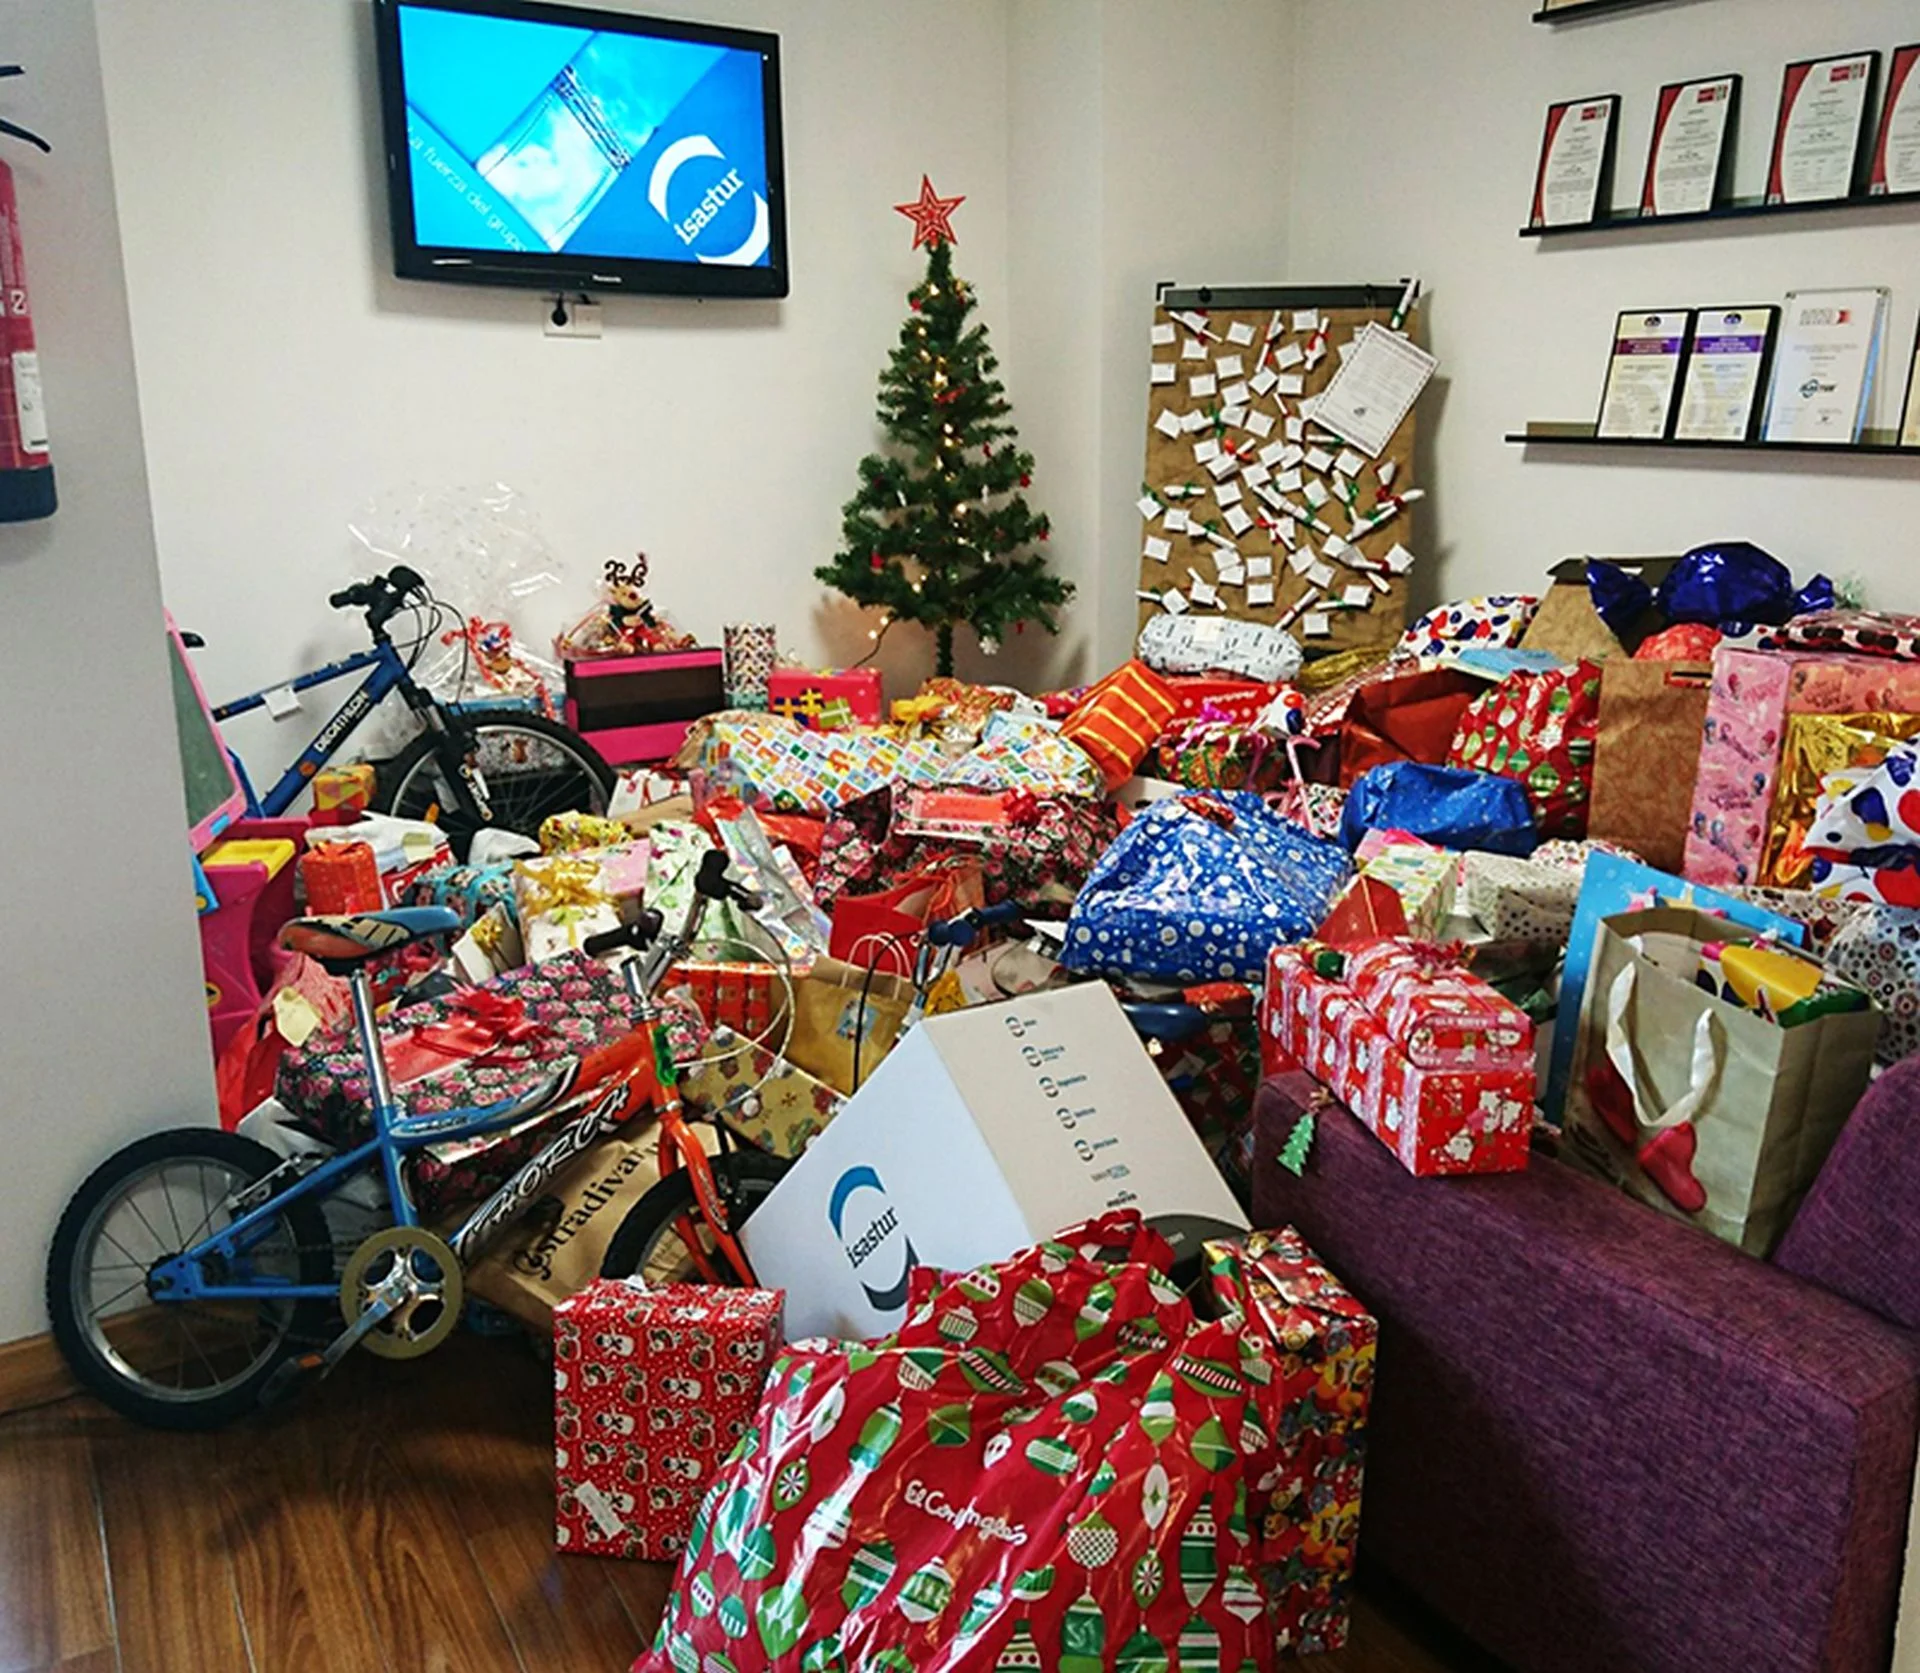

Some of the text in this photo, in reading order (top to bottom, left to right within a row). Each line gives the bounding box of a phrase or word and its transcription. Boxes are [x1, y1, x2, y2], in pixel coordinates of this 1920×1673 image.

[466, 192, 493, 216] del
[673, 167, 744, 246] isastur
[846, 1206, 899, 1269] isastur
